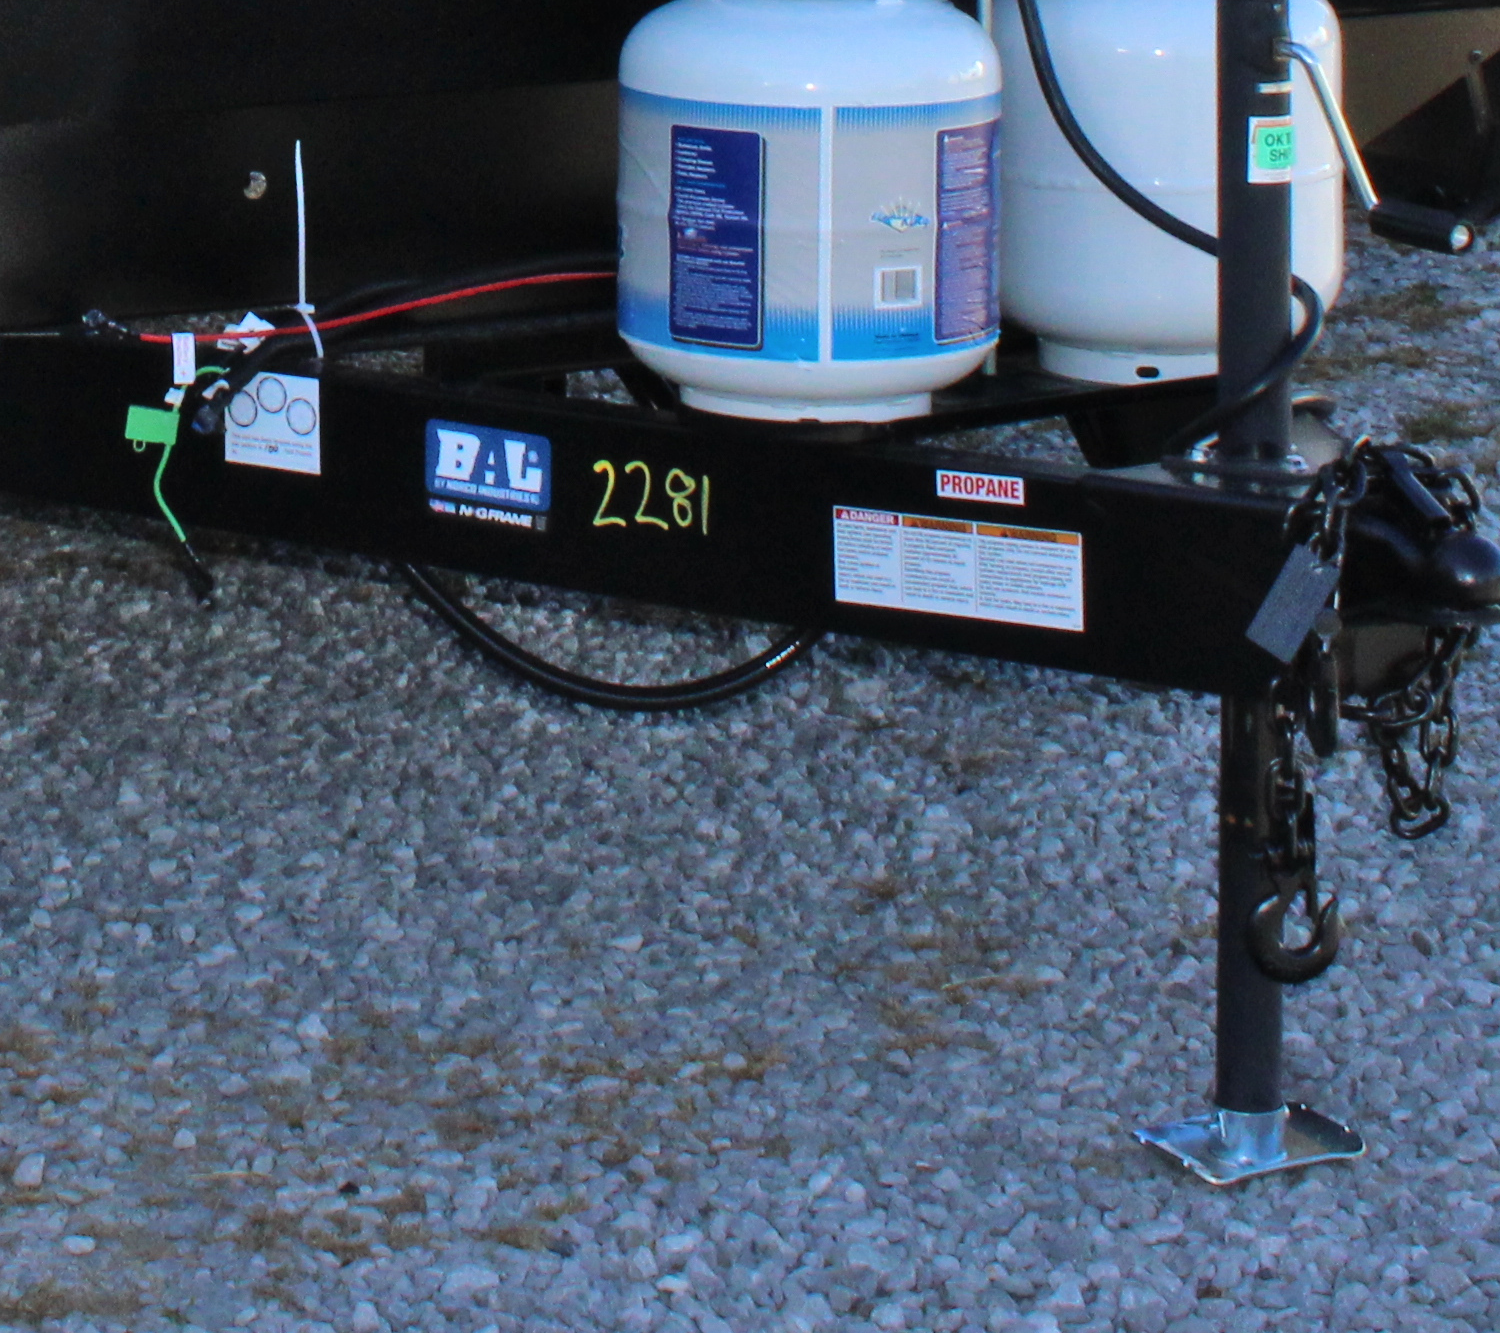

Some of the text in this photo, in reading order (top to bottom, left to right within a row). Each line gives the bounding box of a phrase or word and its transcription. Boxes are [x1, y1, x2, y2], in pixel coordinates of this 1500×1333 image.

[435, 427, 543, 494] BAL
[592, 458, 711, 536] 2281
[939, 473, 1021, 500] PROPANE
[851, 511, 894, 524] DANGER
